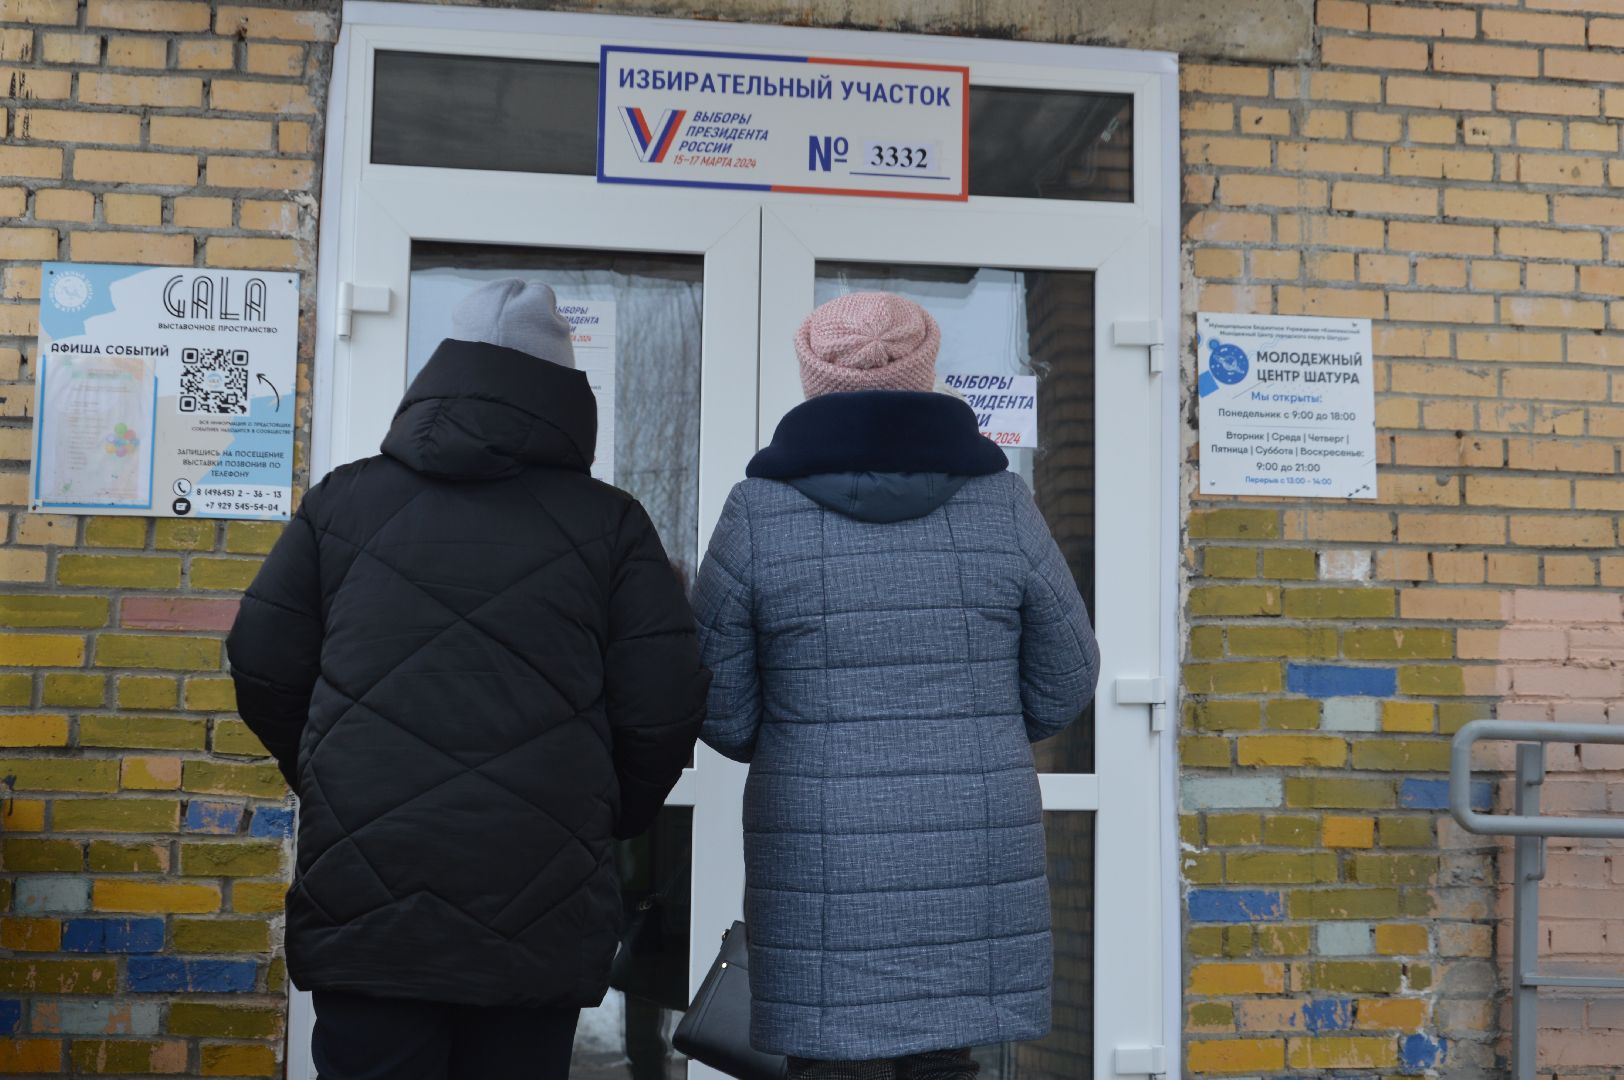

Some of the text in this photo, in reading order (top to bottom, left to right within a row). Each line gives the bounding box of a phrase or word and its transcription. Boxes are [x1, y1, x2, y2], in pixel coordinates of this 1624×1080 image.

[618, 67, 951, 107] ИЗБИРАТЕЛЬНЫЙ УЧАСТОК
[693, 111, 752, 125] ВЫБОРЫ
[685, 126, 769, 141] ПРЕЗИДЕНТА
[679, 141, 733, 154] РОССИИ
[808, 135, 928, 172] № 3332
[701, 156, 732, 167] МАРТА
[733, 158, 757, 168] 2024
[163, 274, 267, 322] GALA
[158, 322, 278, 334] ВЫСТАВОЧНОЕ ПРОСТРАНСТВО
[51, 342, 169, 357] АФИША СОБЫТИЙ
[1256, 350, 1363, 366] МОЛОДЕЖНЫЙ
[944, 375, 1014, 390] ВЫБОРЫ
[1257, 369, 1360, 384] ЦЕНТР ШАТУРА
[962, 394, 1034, 410] ЗИДЕНТА
[1251, 391, 1323, 404] Мы открыты:
[1218, 408, 1281, 419] Понедельник
[1292, 410, 1313, 420] 9:00
[1316, 413, 1327, 421] до
[1330, 411, 1356, 421] 18:00
[1226, 431, 1264, 442] Вторник
[1271, 432, 1301, 443] Среда
[1308, 433, 1345, 444] Четверг
[177, 448, 220, 457] ЗАПИШИСЬ
[235, 450, 285, 459] ПОСЕЩЕНИЕ
[1211, 444, 1248, 455] Пятница
[1255, 446, 1294, 456] Суббота
[1300, 447, 1365, 458] Воскресенье:
[182, 459, 281, 469] ВЫСТАВКИ ПОЗВОНИВ ПО
[1256, 462, 1321, 473] 9:00 до 21:00
[211, 470, 250, 478] ТЕЛЕФОНУ
[196, 488, 202, 496] 8
[204, 488, 235, 497] (49645)
[237, 489, 243, 497] 2
[253, 490, 263, 498] 36
[273, 490, 282, 499] 13
[205, 501, 279, 511] +7 929 545-54-04
